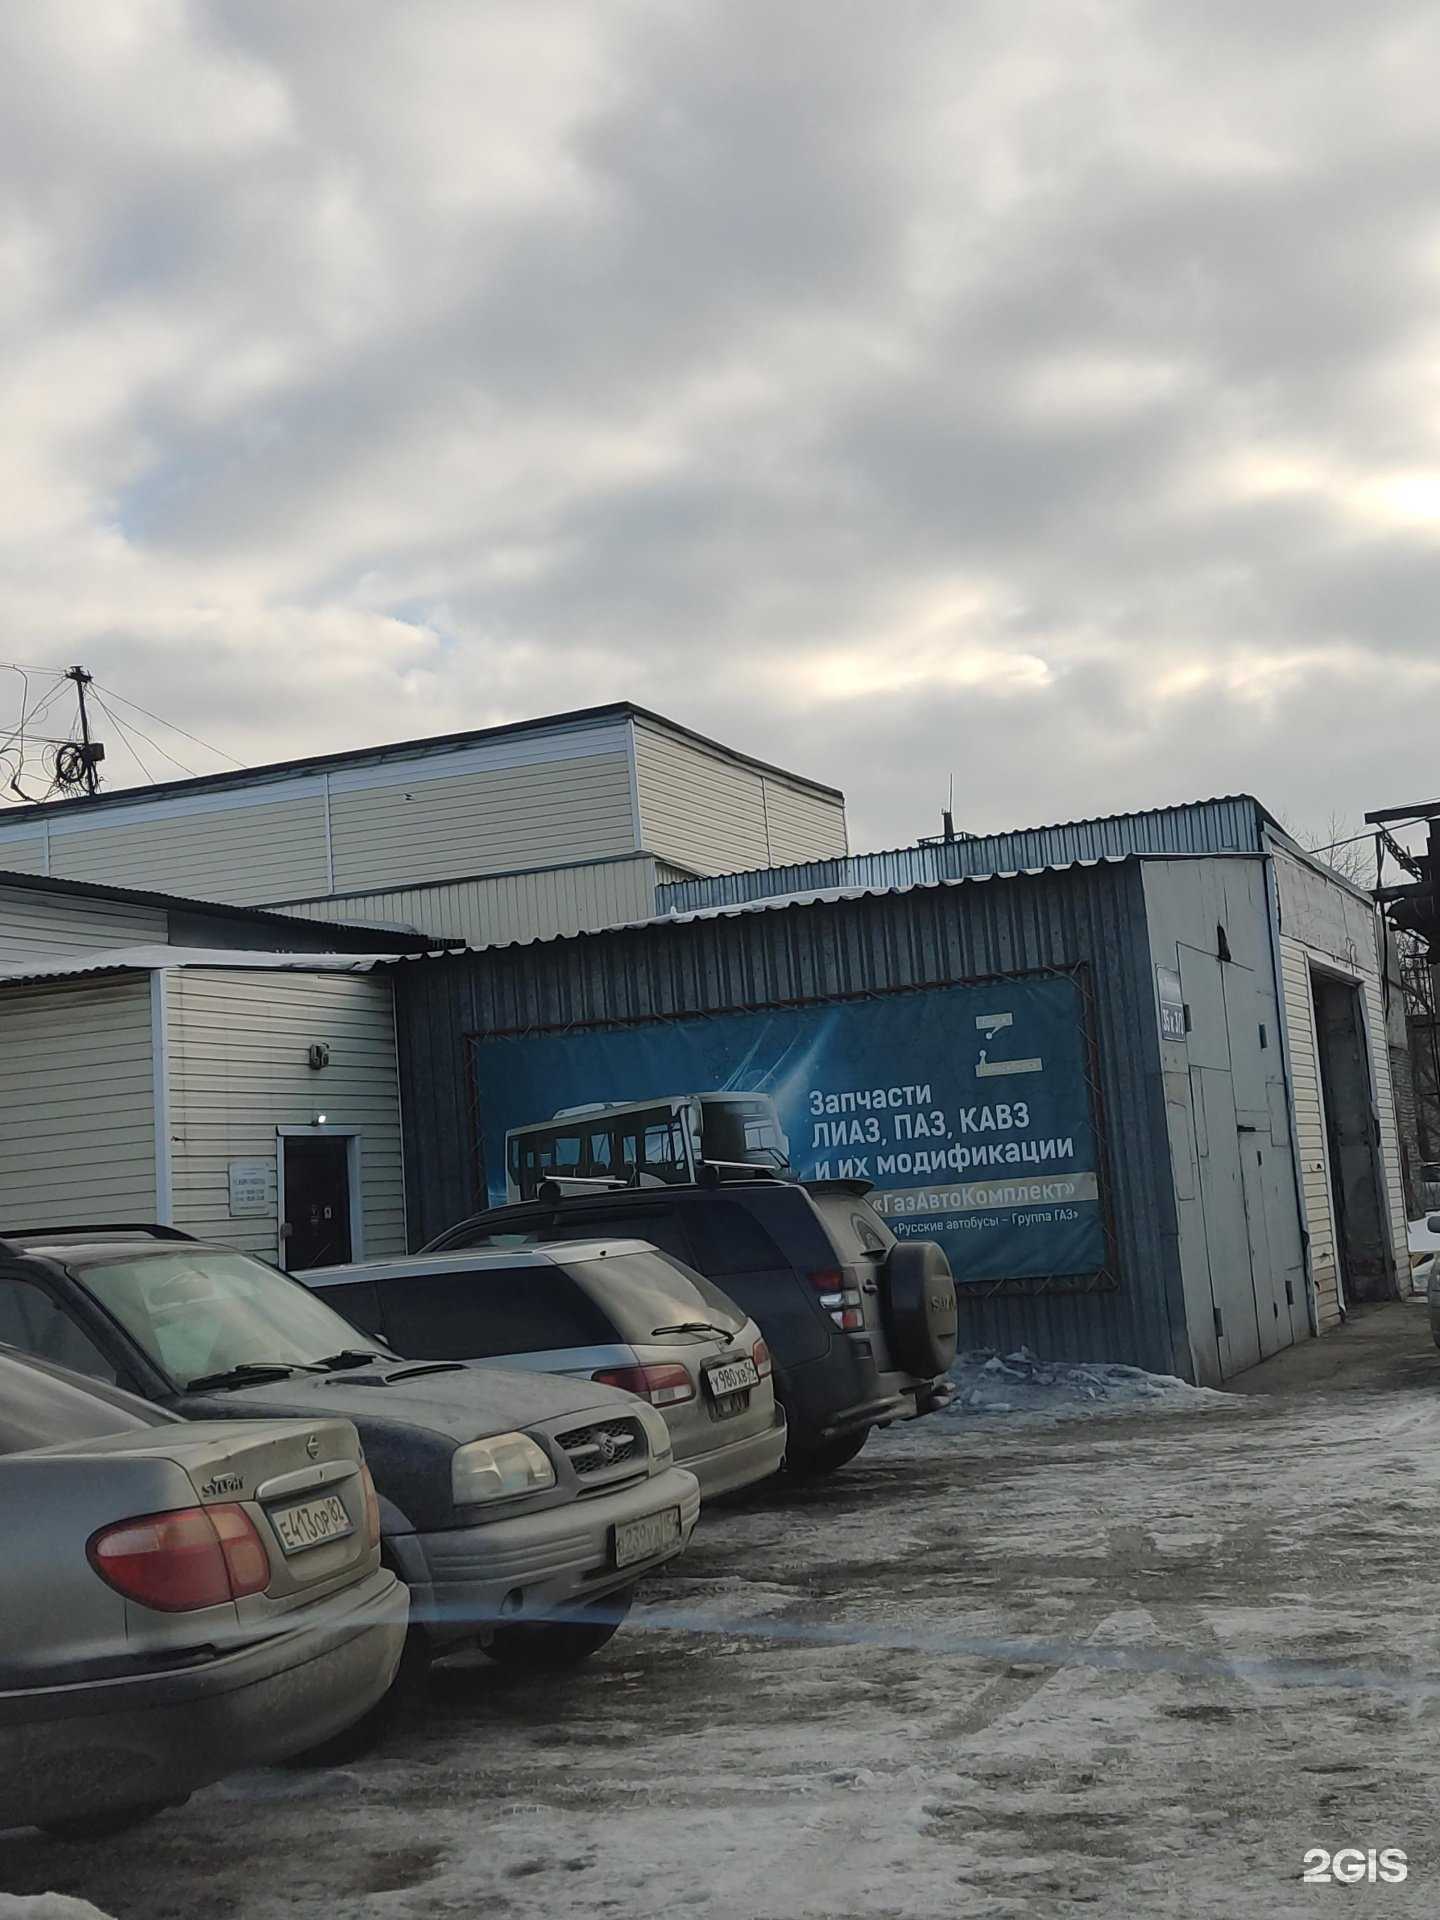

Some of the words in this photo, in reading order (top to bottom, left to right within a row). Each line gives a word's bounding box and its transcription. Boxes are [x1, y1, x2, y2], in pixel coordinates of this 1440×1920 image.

[809, 1084, 932, 1115] Запчасти
[811, 1117, 887, 1148] ЛИАЗ,
[894, 1111, 953, 1140] ПАЗ,
[959, 1102, 1030, 1132] КАВЗ
[815, 1161, 830, 1180] и
[838, 1156, 869, 1179] их
[877, 1137, 1074, 1172] модификации
[872, 1182, 1075, 1214] «ГазАвтоКомплект»
[946, 1216, 999, 1231] автобусы
[1012, 1211, 1052, 1226] Группа
